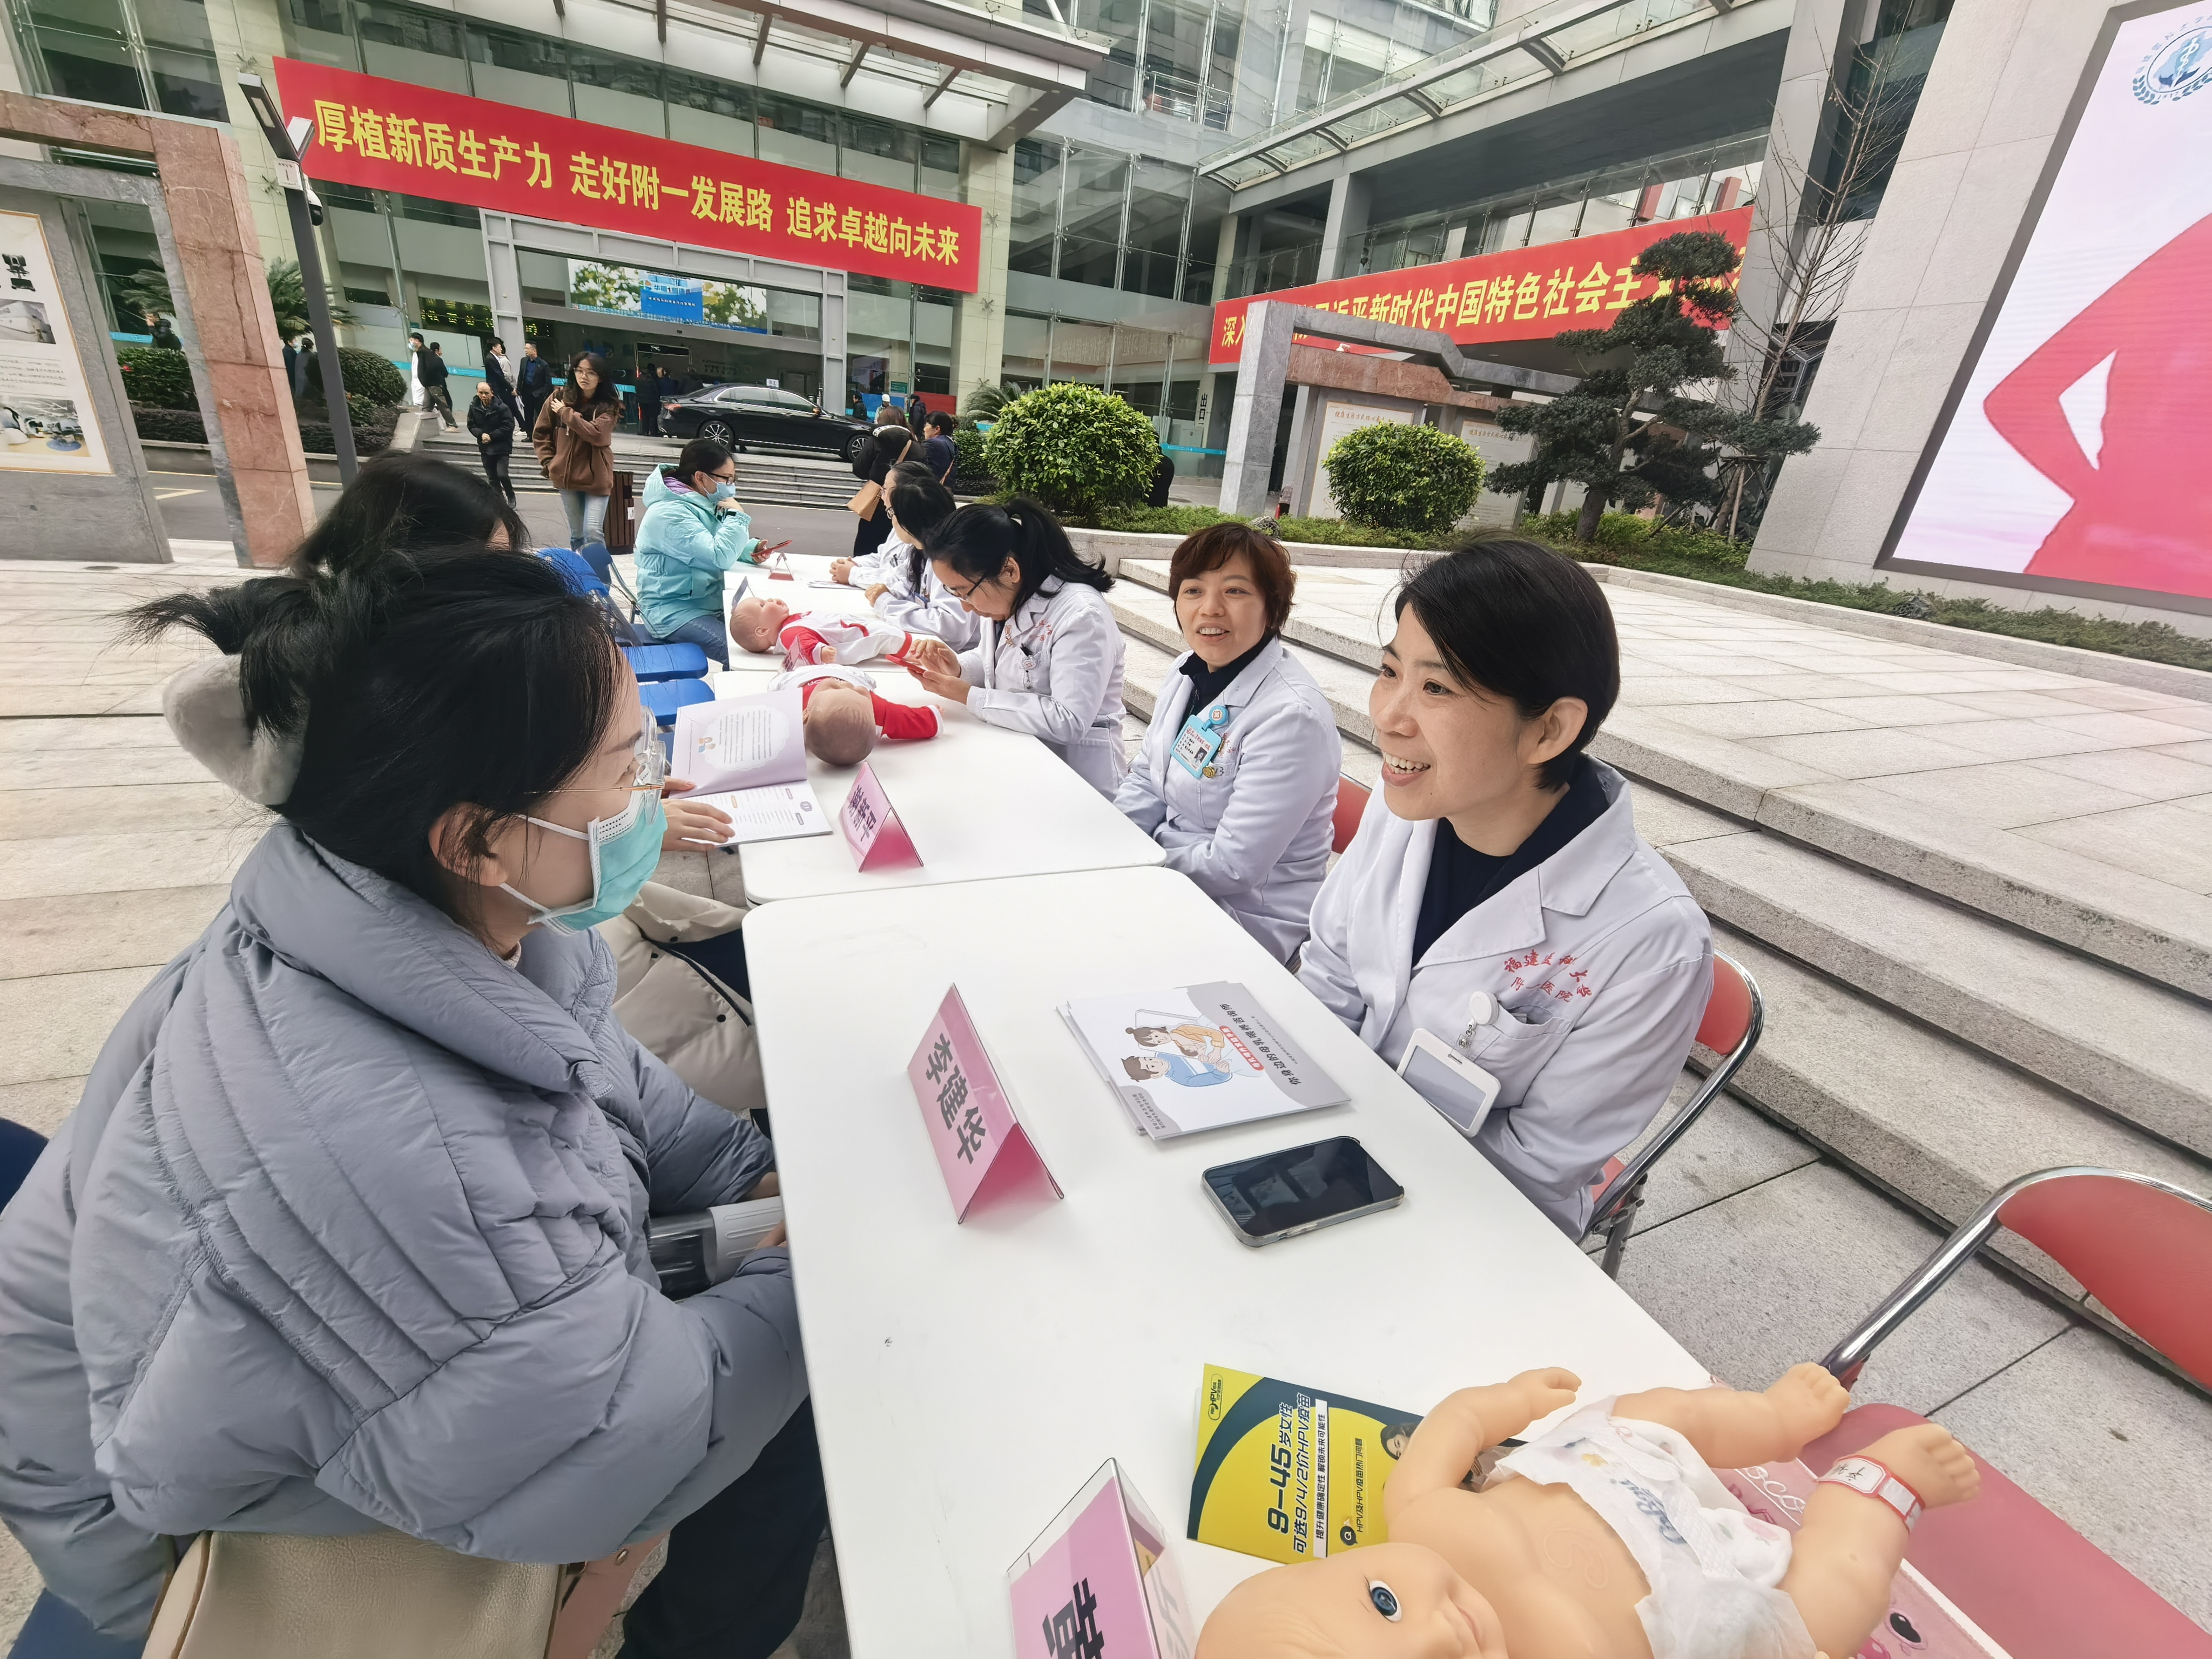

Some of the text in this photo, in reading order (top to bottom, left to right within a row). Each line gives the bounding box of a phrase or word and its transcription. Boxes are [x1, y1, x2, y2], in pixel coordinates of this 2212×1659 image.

[314, 99, 960, 266] 厚植新质生产力 走好附一发展路 追求卓越向未来
[1198, 393, 1208, 421] 出口
[925, 1032, 987, 1165] 李建华
[1292, 1392, 1312, 1554] 可选9/4/2价HPV疫苗
[1315, 1413, 1327, 1540] 提升健康确定性 解锁未来可能性
[1354, 1437, 1364, 1533] HPV及HPV疫苗热门问题
